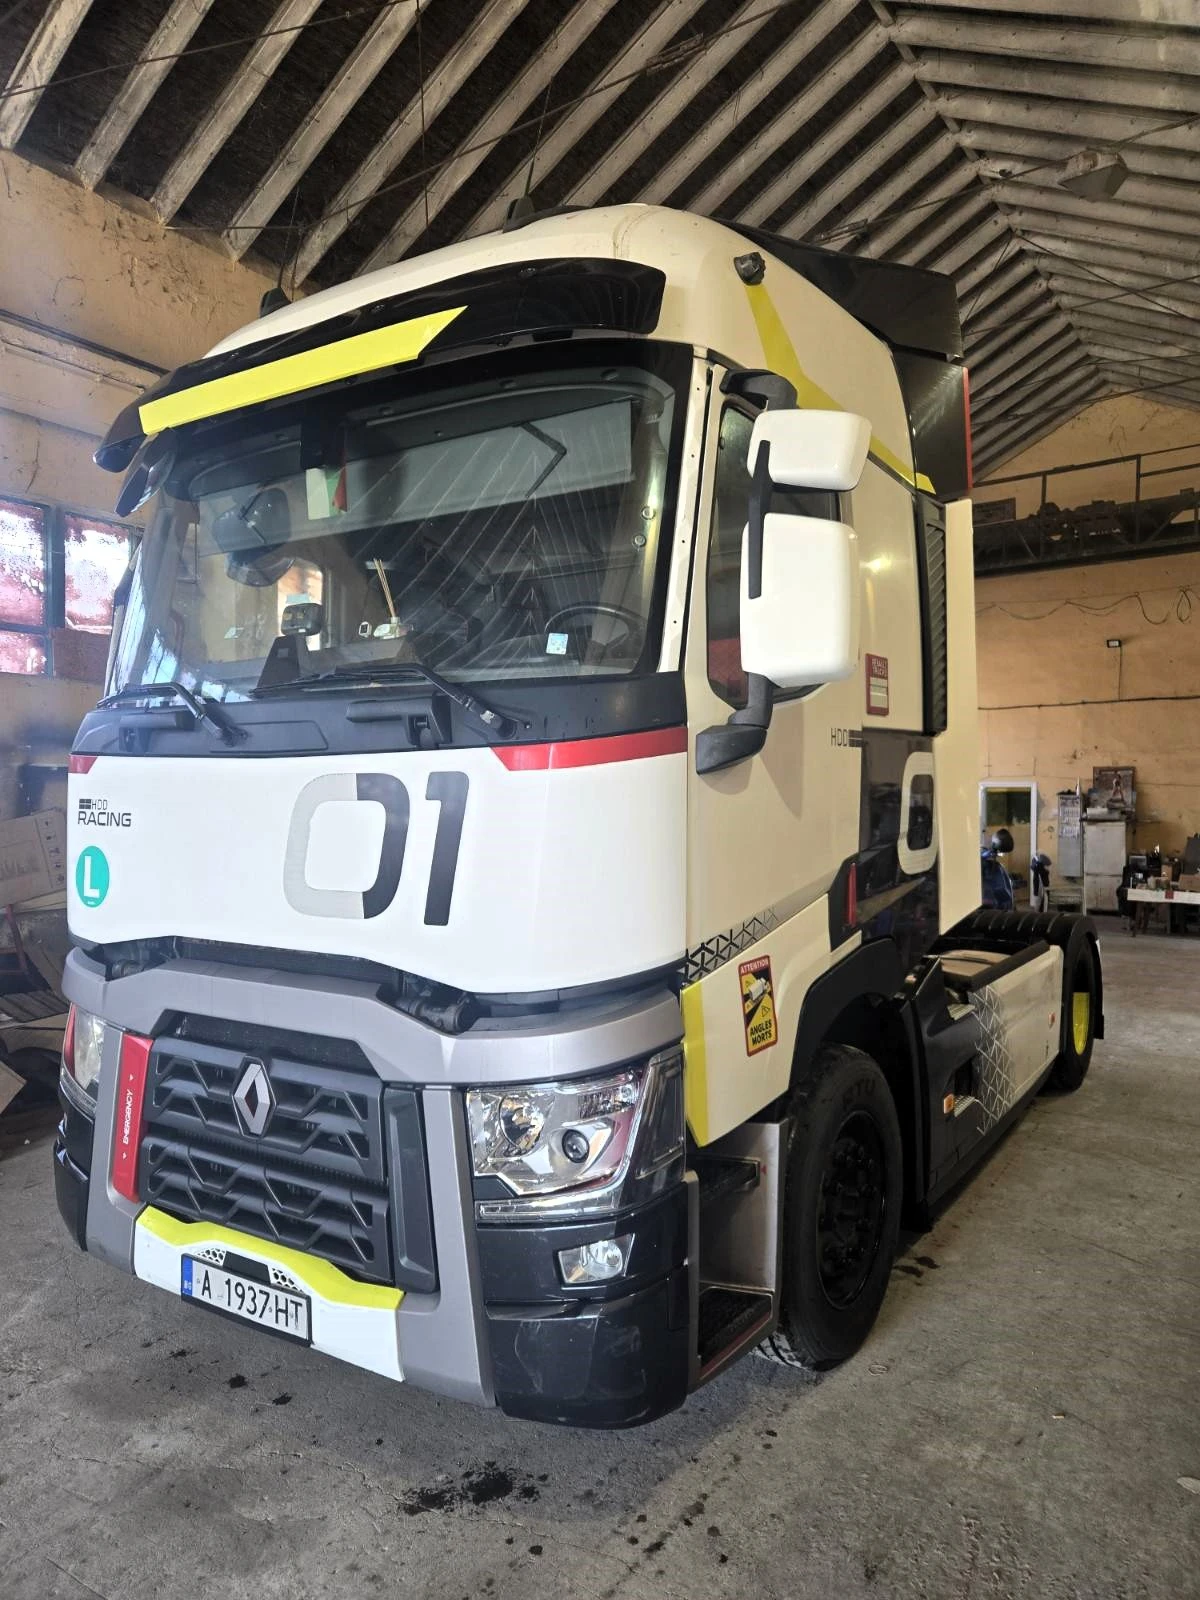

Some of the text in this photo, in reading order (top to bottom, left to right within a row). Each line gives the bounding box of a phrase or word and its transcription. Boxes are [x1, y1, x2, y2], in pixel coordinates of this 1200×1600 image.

[829, 727, 849, 747] HDD
[77, 810, 132, 827] RACING
[283, 770, 470, 926] 01
[83, 855, 100, 898] L
[750, 1018, 772, 1037] ANGLES
[751, 1029, 772, 1046] MORTS
[122, 1088, 133, 1145] EMERGENCY
